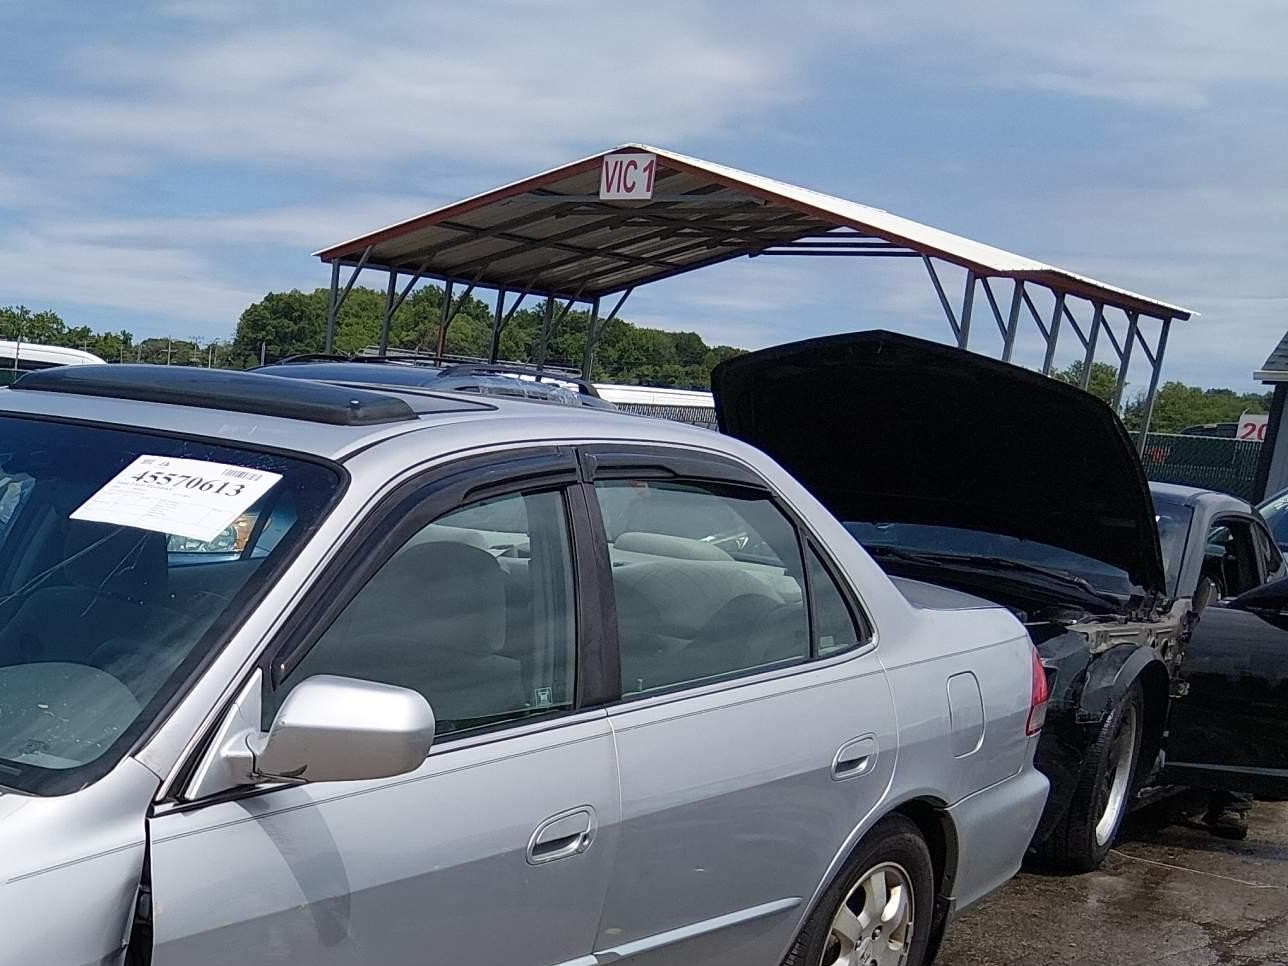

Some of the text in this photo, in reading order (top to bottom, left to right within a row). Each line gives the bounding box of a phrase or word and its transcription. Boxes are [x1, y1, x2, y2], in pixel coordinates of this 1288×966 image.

[604, 159, 656, 194] VIC 1
[131, 470, 246, 497] 45570613
